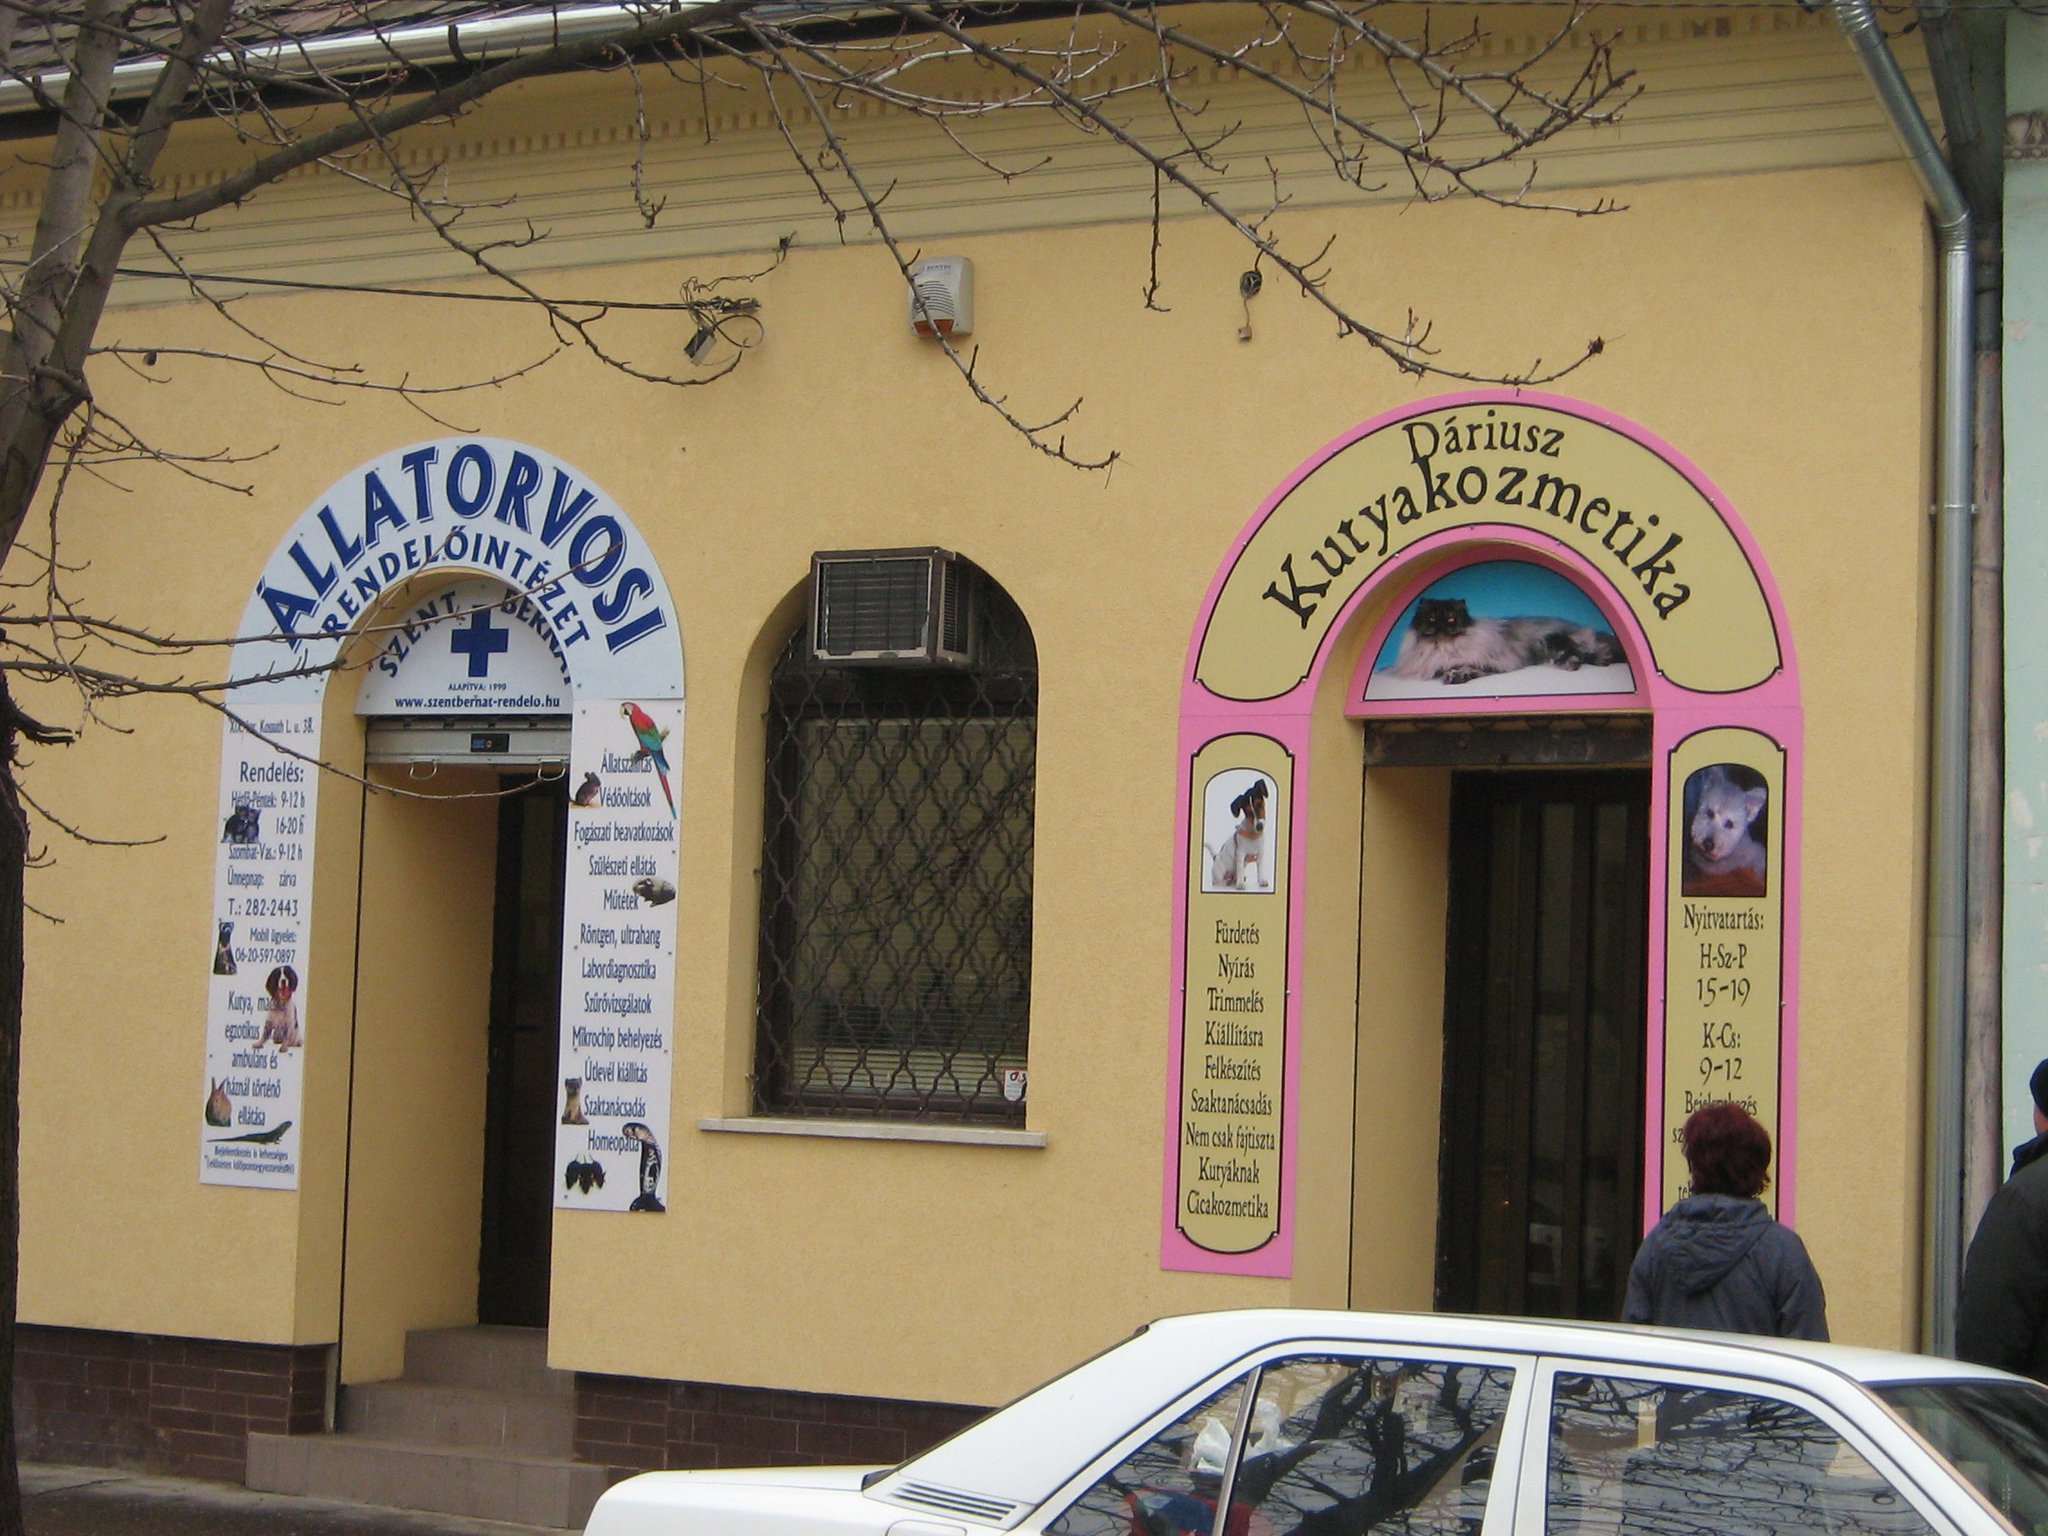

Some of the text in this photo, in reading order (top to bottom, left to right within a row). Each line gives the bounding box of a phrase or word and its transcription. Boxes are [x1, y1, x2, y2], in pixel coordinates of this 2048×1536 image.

[1402, 409, 1565, 464] Dáriusz
[256, 443, 667, 655] ÁLLATORVOSI
[1262, 455, 1691, 630] Kutyakozmetika
[321, 525, 590, 648] RENDELŐINTÉZET
[380, 591, 456, 678] SZENT
[395, 695, 560, 708] www.szentbernat-rendelo.hu
[240, 761, 304, 782] Rendelés:
[281, 791, 298, 808] 9-12
[600, 786, 651, 807] Védőoltások
[276, 818, 297, 834] 16-20
[574, 821, 674, 845] Fogászati beavatkozások
[279, 843, 296, 860] 9-12
[589, 854, 656, 876] Szülészeti ellátás
[279, 870, 296, 887] zárva
[228, 898, 298, 916] T.: 282-2443
[603, 888, 639, 910] Műtétek
[1215, 919, 1260, 945] Fürdetés
[1684, 904, 1764, 936] Nyitvatartás:
[580, 923, 661, 949] Röntgen, ultrahang
[235, 948, 296, 963] 06-20-597-0897
[1700, 943, 1747, 969] H-Sz-P
[582, 957, 656, 982] Labordiagnosztika
[1218, 954, 1255, 984] Nyírás
[584, 991, 652, 1017] Szűrővizsgálatok
[1207, 987, 1264, 1013] Trimmelés
[1697, 977, 1750, 1007] 15-19
[572, 1026, 662, 1053] Mikrochip behelyezés
[1205, 1020, 1263, 1047] Kiállításra
[1702, 1022, 1741, 1049] K-Cs:
[270, 1049, 278, 1069] és
[1205, 1054, 1261, 1081] Felkészítés
[1700, 1056, 1742, 1085] 9-12
[584, 1094, 646, 1118] Szaktanácsadás
[1191, 1088, 1272, 1115] Szaktanácsadás
[1185, 1122, 1275, 1157] Nem csak fajtiszta
[1199, 1156, 1259, 1188] Kutyáknak
[1187, 1189, 1269, 1218] Cicakozmetika
